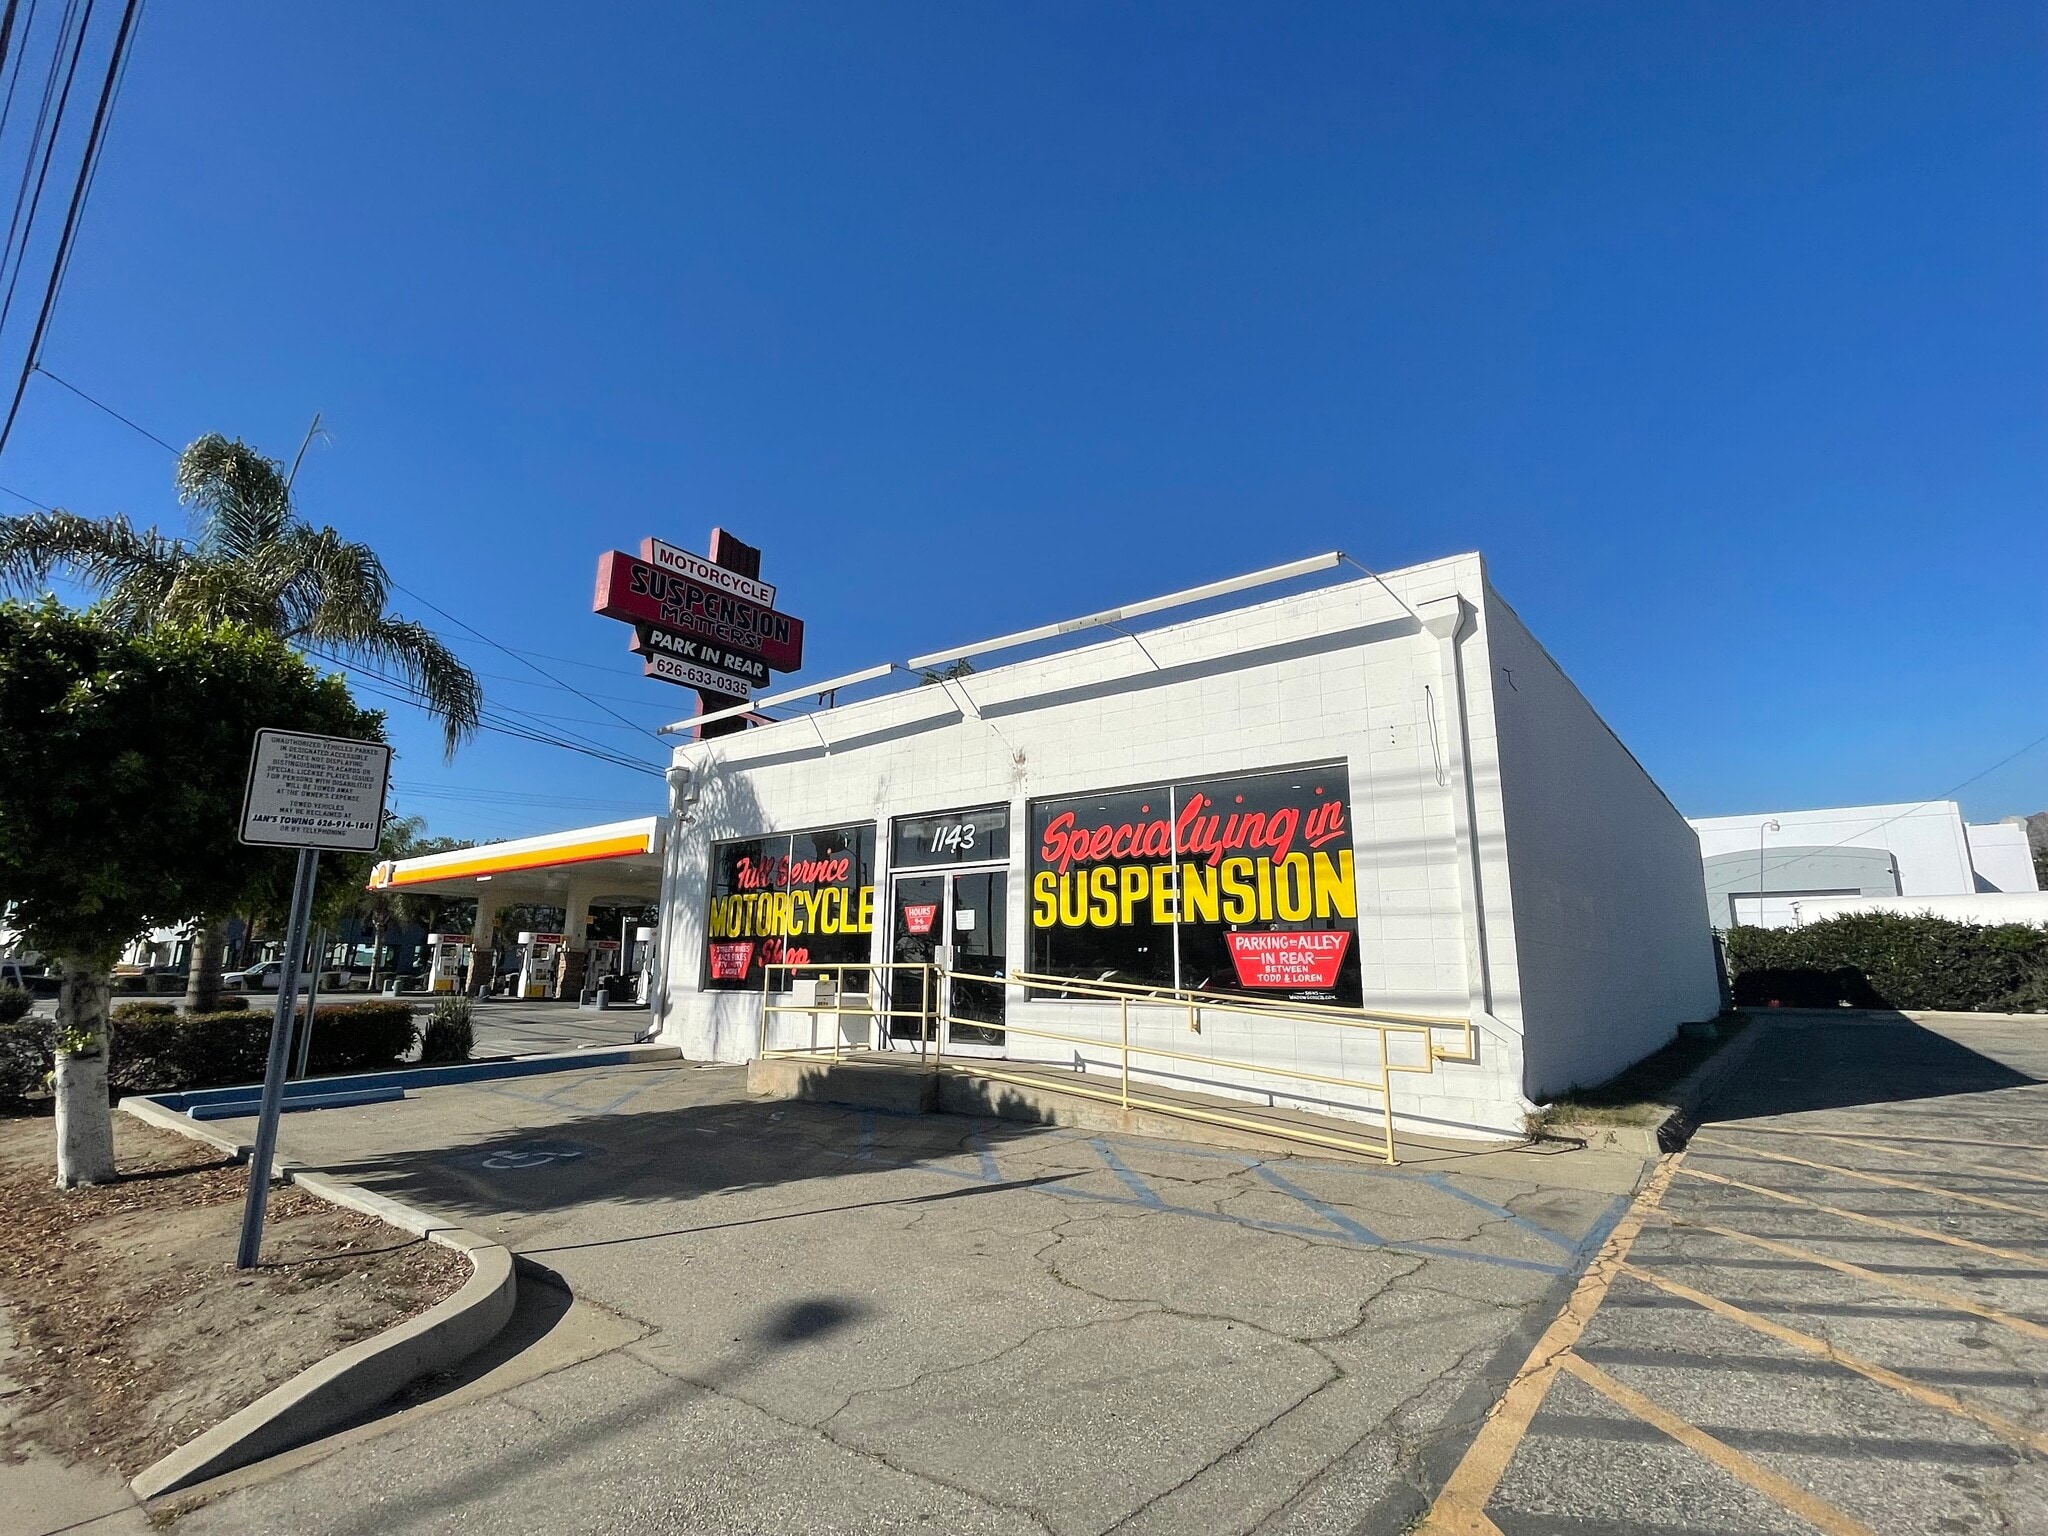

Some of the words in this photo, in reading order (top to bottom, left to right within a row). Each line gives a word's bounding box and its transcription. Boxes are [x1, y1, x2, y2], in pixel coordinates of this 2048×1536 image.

[659, 549, 769, 602] MOTORCYCLE
[630, 564, 790, 644] SUSPENSION
[659, 603, 764, 651] MATTERS!
[650, 630, 696, 657] PARK
[701, 646, 720, 664] IN
[724, 653, 763, 678] REAR
[656, 658, 748, 695] 626-633-0335
[271, 736, 322, 748] UNAUTHORIZED
[323, 744, 353, 752] VEHICLES
[354, 747, 379, 755] PARKED
[289, 746, 329, 756] DESIGNATED
[331, 751, 368, 761] ACCESSIBLE
[272, 759, 326, 770] DISTINGUISHING
[327, 765, 360, 774] PLACARDS
[325, 758, 364, 767] DISPLAYING
[267, 765, 295, 774] SPECIAL
[297, 769, 325, 777] LICENSE
[326, 772, 350, 780] PLATES
[282, 774, 313, 783] PERSONS
[332, 780, 372, 789] DISABILITIES
[301, 791, 329, 799] OWNER'S
[331, 793, 360, 802] EXPENSE
[306, 809, 342, 818] RECLAIMED
[314, 803, 345, 811] VEHICLES
[252, 814, 278, 823] JAN'S
[280, 816, 315, 826] TOWING
[316, 819, 374, 830] 626-914-1841
[302, 827, 347, 836] TELEPHONING
[931, 823, 976, 854] 1143
[1040, 793, 1300, 877] Specializing
[1304, 786, 1345, 848] in
[736, 855, 776, 889] Full
[776, 847, 850, 888] Service
[1032, 849, 1357, 928] SUSPENSION
[708, 885, 874, 938] MOTORCYCLE
[909, 907, 931, 916] HOURS
[1235, 936, 1288, 951] PARKING
[1298, 935, 1343, 950] ALLEY
[758, 938, 811, 976] Shop
[1260, 952, 1275, 964] IN
[1279, 952, 1315, 965] REAR
[1265, 965, 1309, 973] BETWEEN
[1257, 974, 1281, 982] TODD
[1284, 974, 1291, 983] &
[1293, 974, 1323, 982] LOREN
